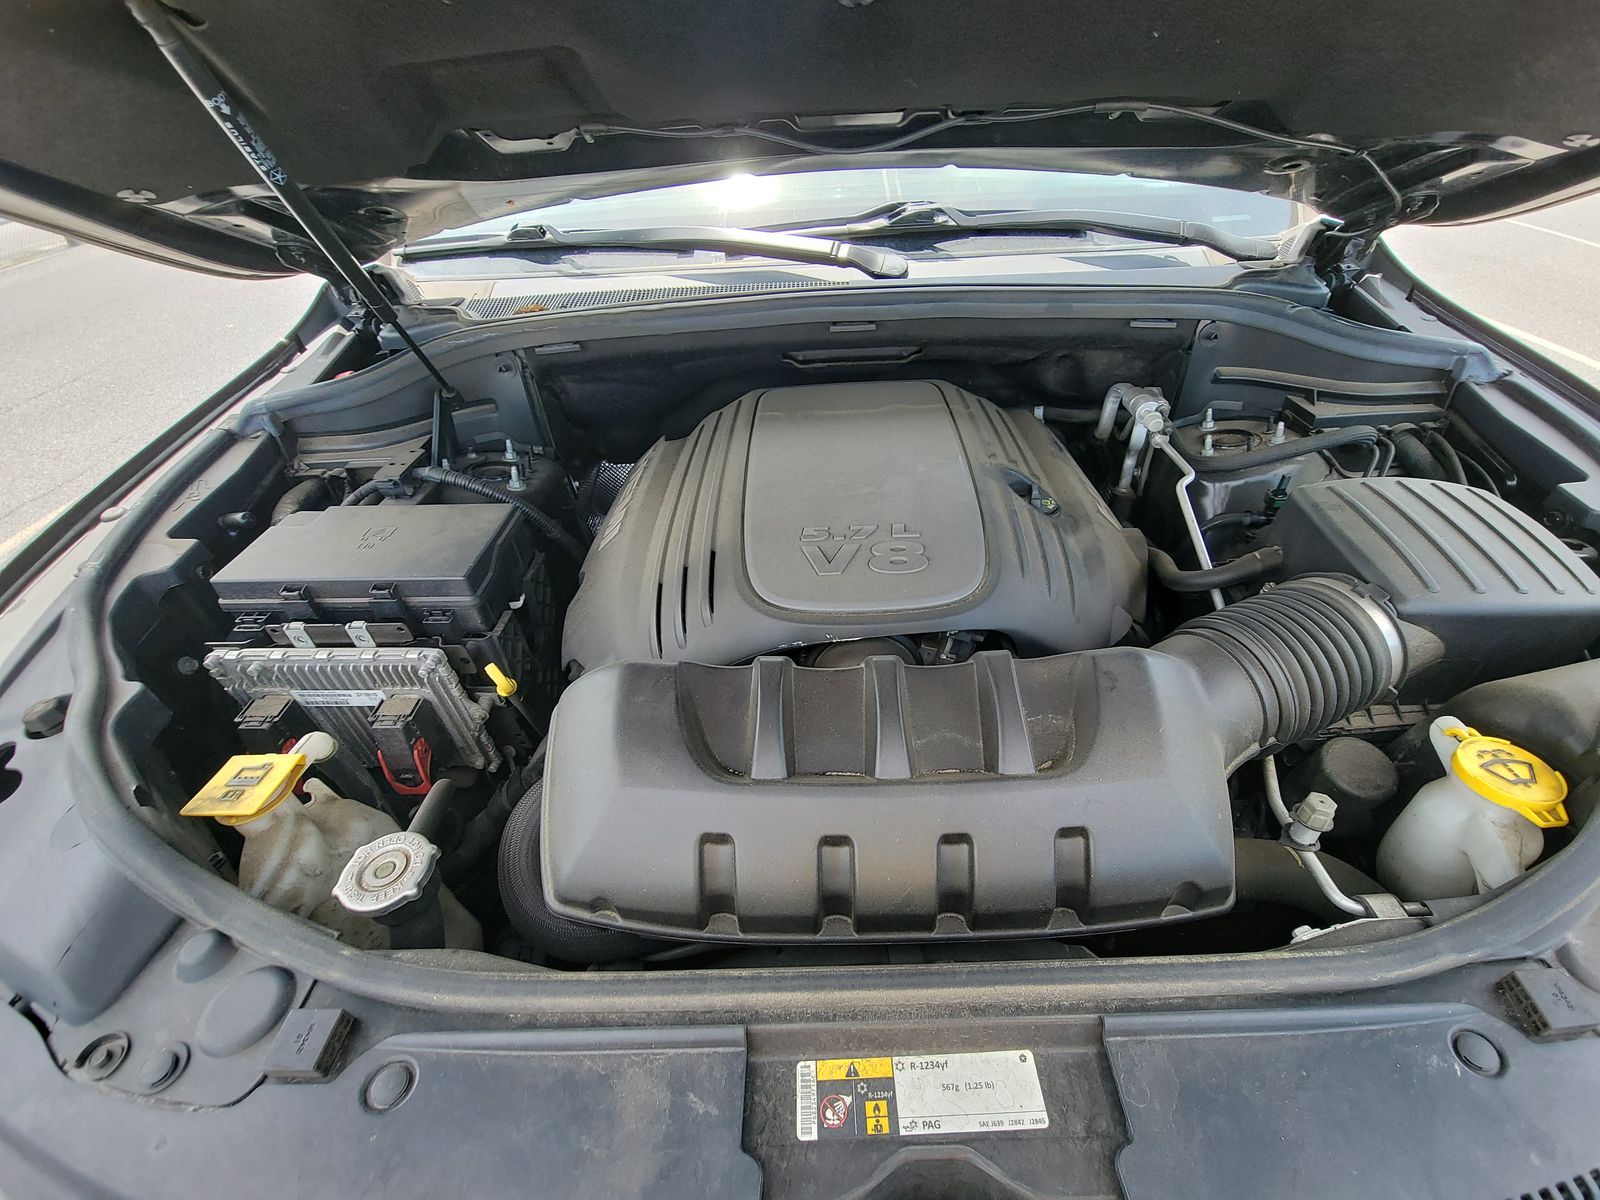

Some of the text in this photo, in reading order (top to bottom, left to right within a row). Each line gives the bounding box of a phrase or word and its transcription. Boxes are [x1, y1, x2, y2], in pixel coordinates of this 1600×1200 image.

[799, 540, 929, 576] V8
[376, 836, 406, 849] OPEN
[352, 847, 373, 867] HOT
[371, 882, 405, 902] KEEP
[910, 1060, 949, 1071] R-1234yf
[941, 1080, 995, 1093] 567g (1.25 lb)
[922, 1120, 941, 1130] PAG
[978, 1120, 990, 1128] SAE
